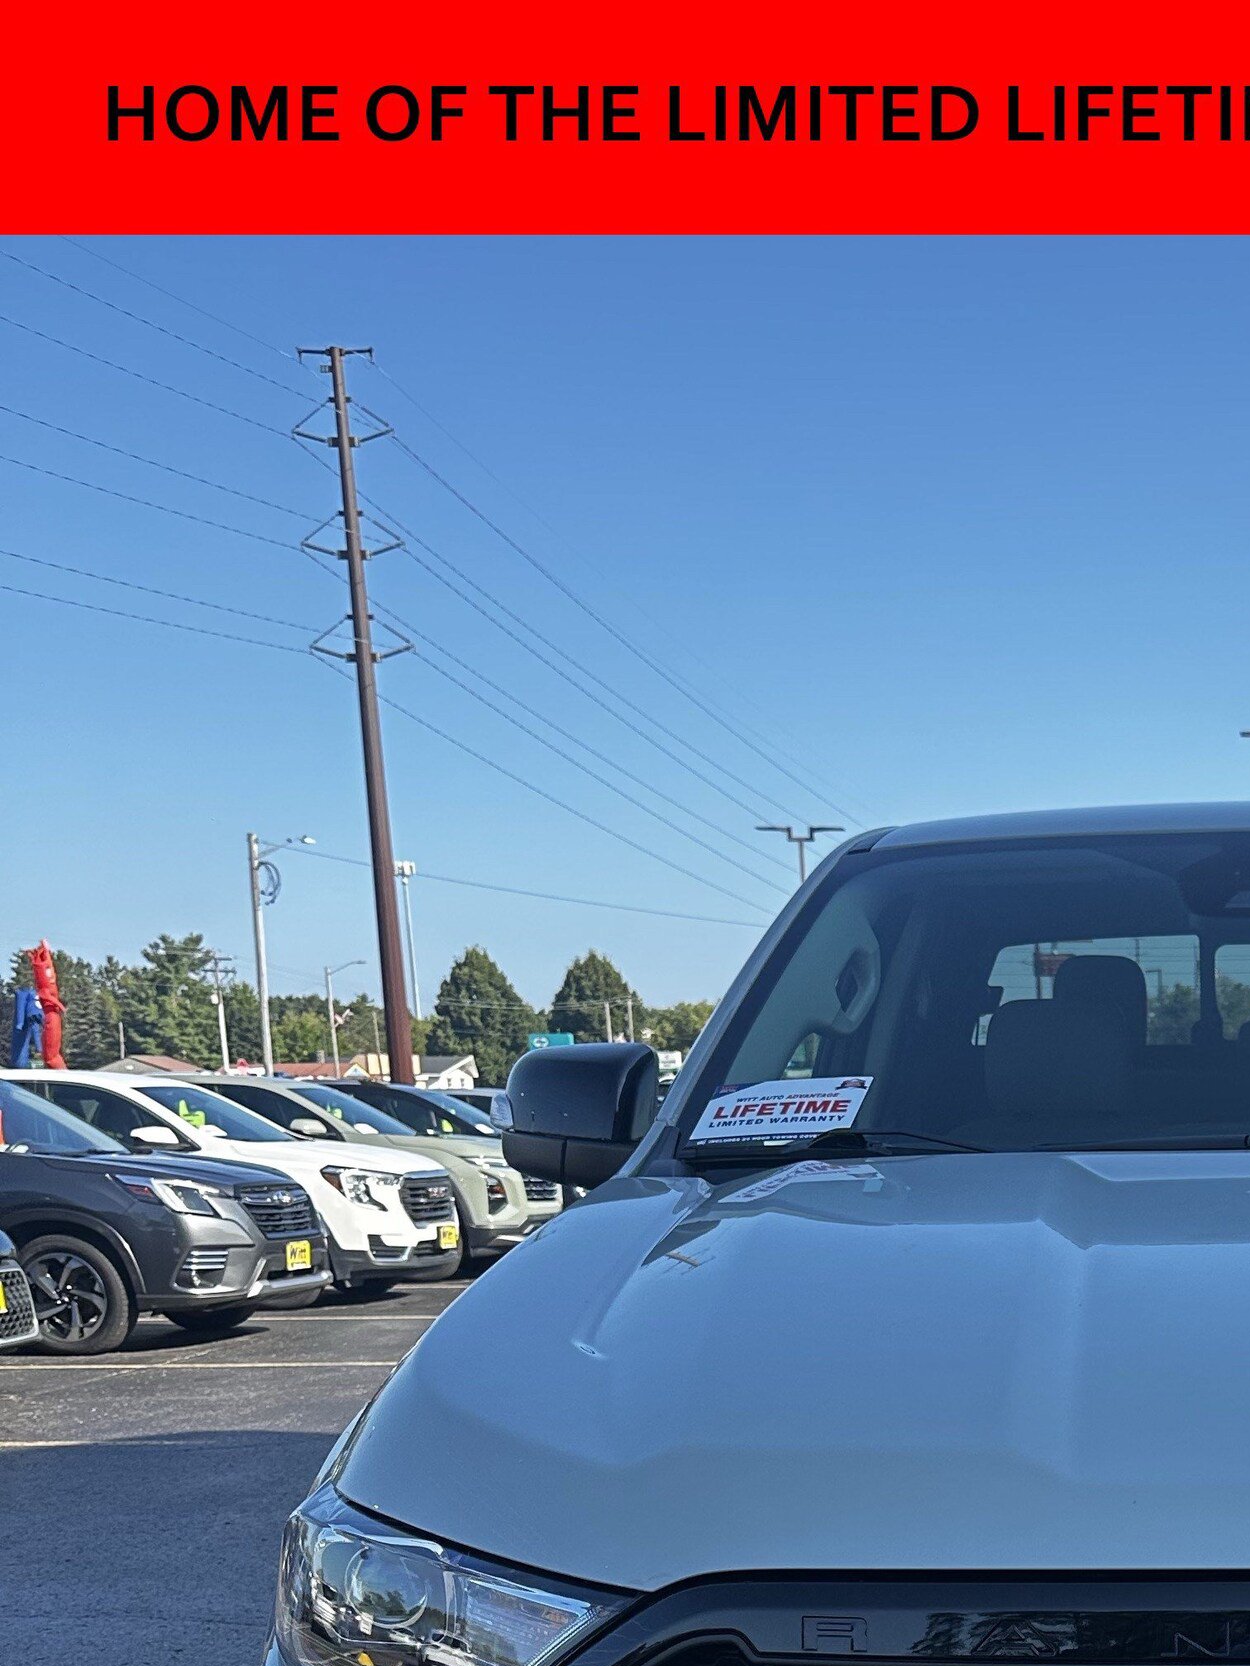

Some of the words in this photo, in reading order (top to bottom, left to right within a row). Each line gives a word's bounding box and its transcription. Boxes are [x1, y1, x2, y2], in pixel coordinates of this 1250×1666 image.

[786, 1092, 840, 1100] ADVANTAGE
[713, 1100, 852, 1119] LIFETIME
[709, 1119, 763, 1128] LIMITED
[769, 1115, 845, 1124] WARRANTY
